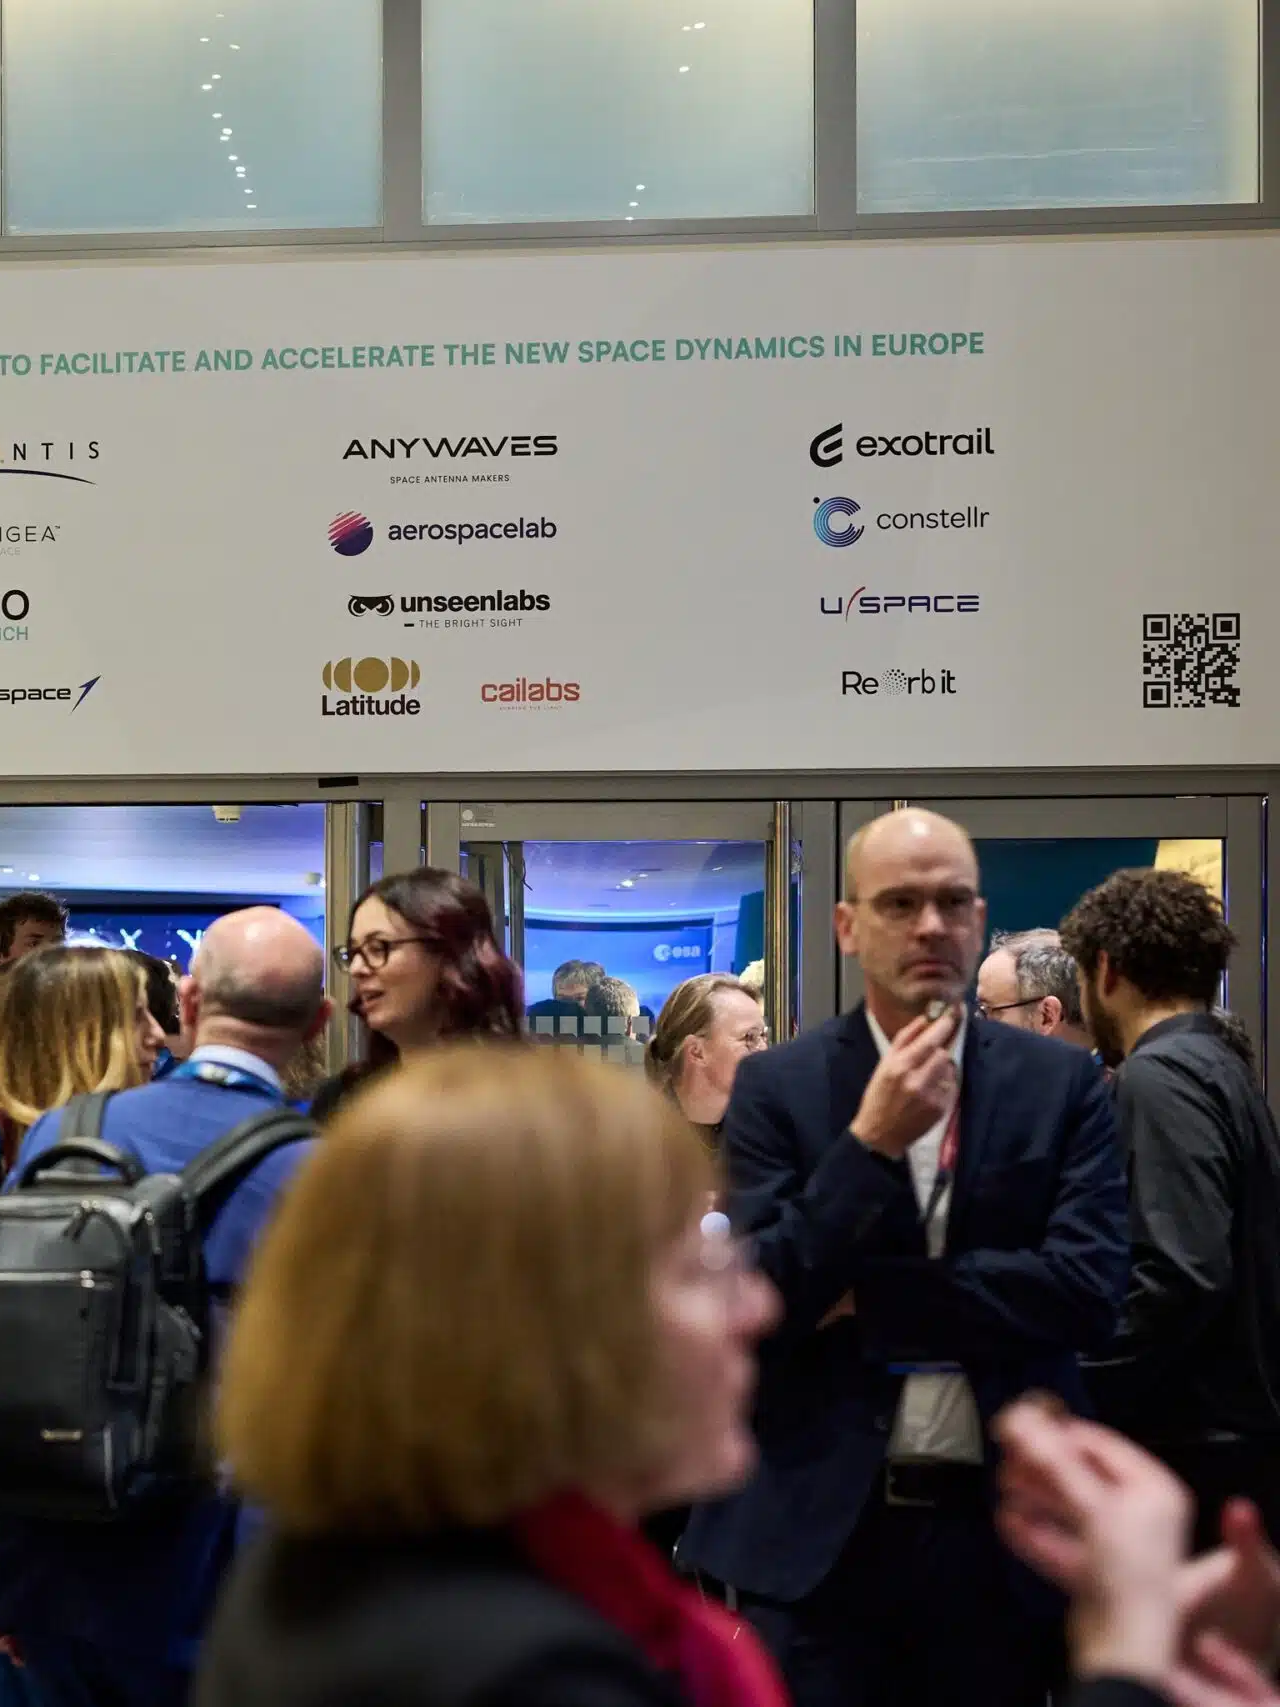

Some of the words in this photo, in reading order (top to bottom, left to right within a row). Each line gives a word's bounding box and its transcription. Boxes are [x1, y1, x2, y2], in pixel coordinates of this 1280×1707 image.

[39, 350, 186, 376] FACILITATE
[195, 348, 253, 373] AND
[261, 344, 435, 370] ACCELERATE
[445, 342, 496, 367] THE
[505, 341, 569, 366] NEW
[577, 338, 666, 364] SPACE
[675, 335, 825, 361] DYNAMICS
[833, 335, 863, 357] IN
[870, 331, 985, 357] EUROPE
[342, 435, 559, 460] ANYWAVES
[855, 427, 995, 457] exotrail
[389, 476, 421, 485] SPACE
[423, 475, 469, 484] ANTENNA
[470, 474, 511, 483] MAKERS
[876, 506, 990, 530] constellr
[388, 516, 558, 545] aerospacelab
[400, 589, 551, 613] unseenlabs
[419, 619, 440, 628] THE
[444, 618, 485, 628] BRIGHT
[489, 617, 523, 627] SIGHT
[481, 676, 581, 703] cailabs
[321, 693, 422, 717] Latitude
